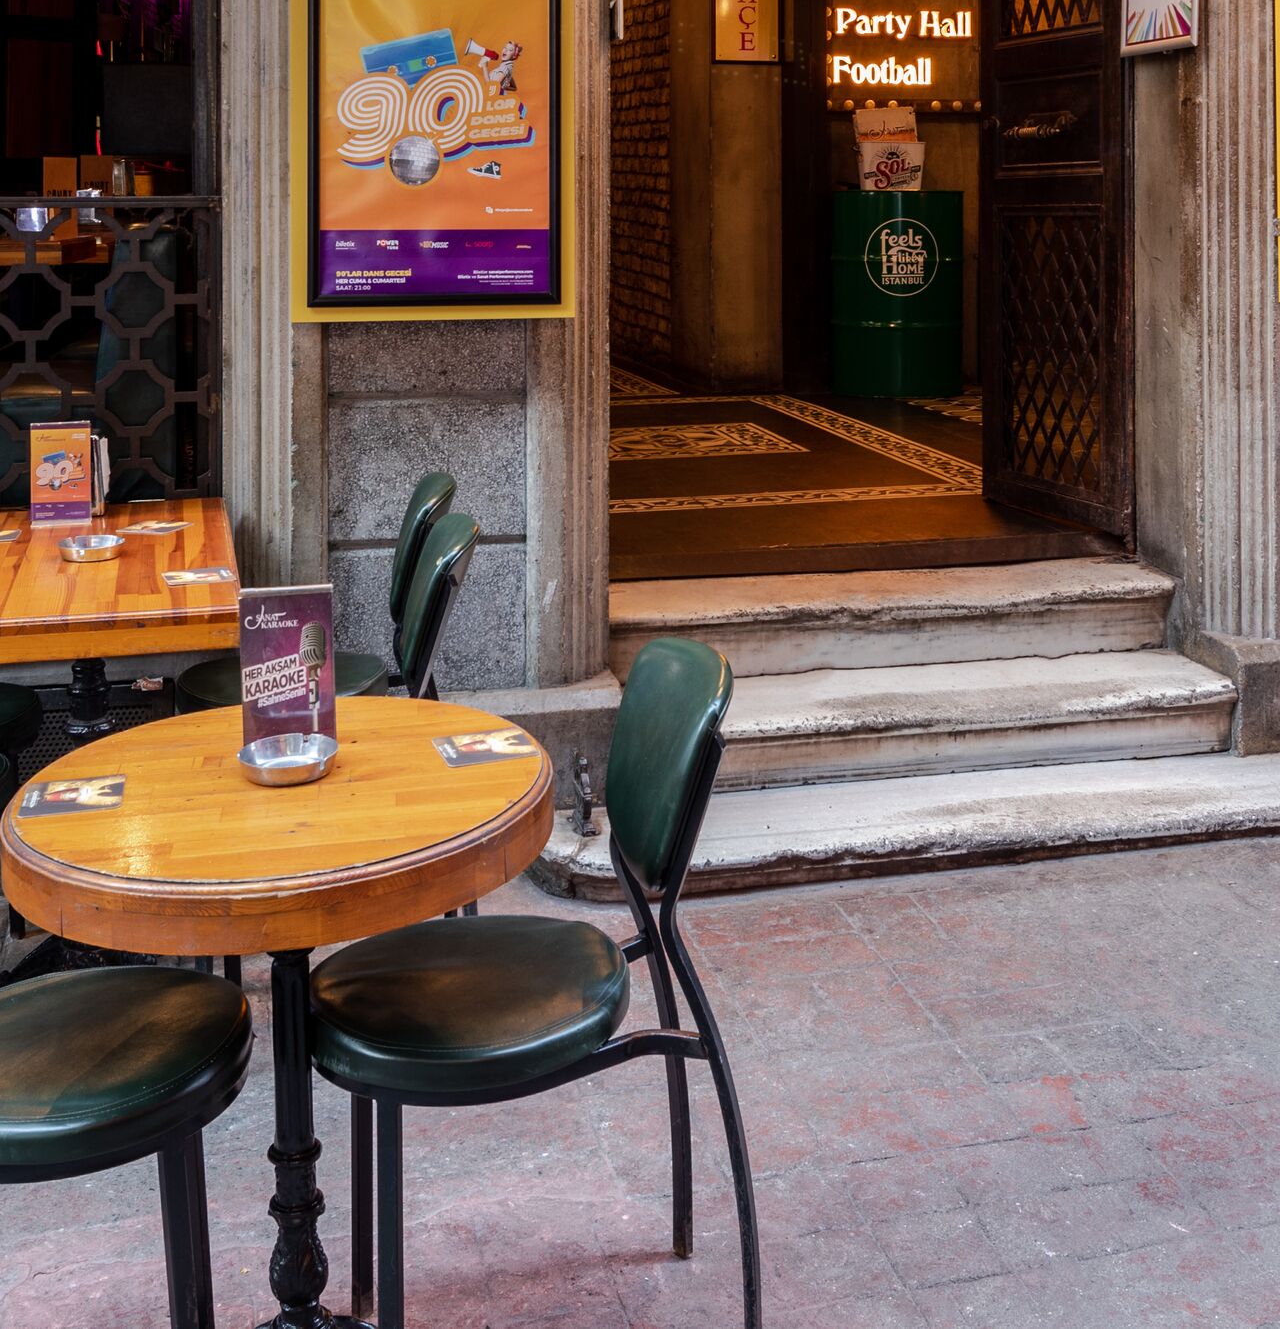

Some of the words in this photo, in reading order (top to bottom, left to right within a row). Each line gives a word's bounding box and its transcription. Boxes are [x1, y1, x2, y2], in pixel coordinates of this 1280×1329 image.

[835, 7, 913, 40] Party
[919, 9, 972, 37] Hall
[832, 55, 932, 86] Football
[336, 68, 484, 159] 90
[874, 158, 911, 190] SOL
[880, 228, 923, 255] feels
[882, 254, 924, 274] HOME
[881, 277, 925, 285] ISTANBUL
[244, 604, 287, 630] SANAT
[261, 619, 299, 629] KARAOKE
[244, 669, 263, 682] HER
[264, 656, 298, 676] AKŞAM
[245, 671, 305, 699] KARAOKE
[257, 687, 307, 709] #SahneSenin
